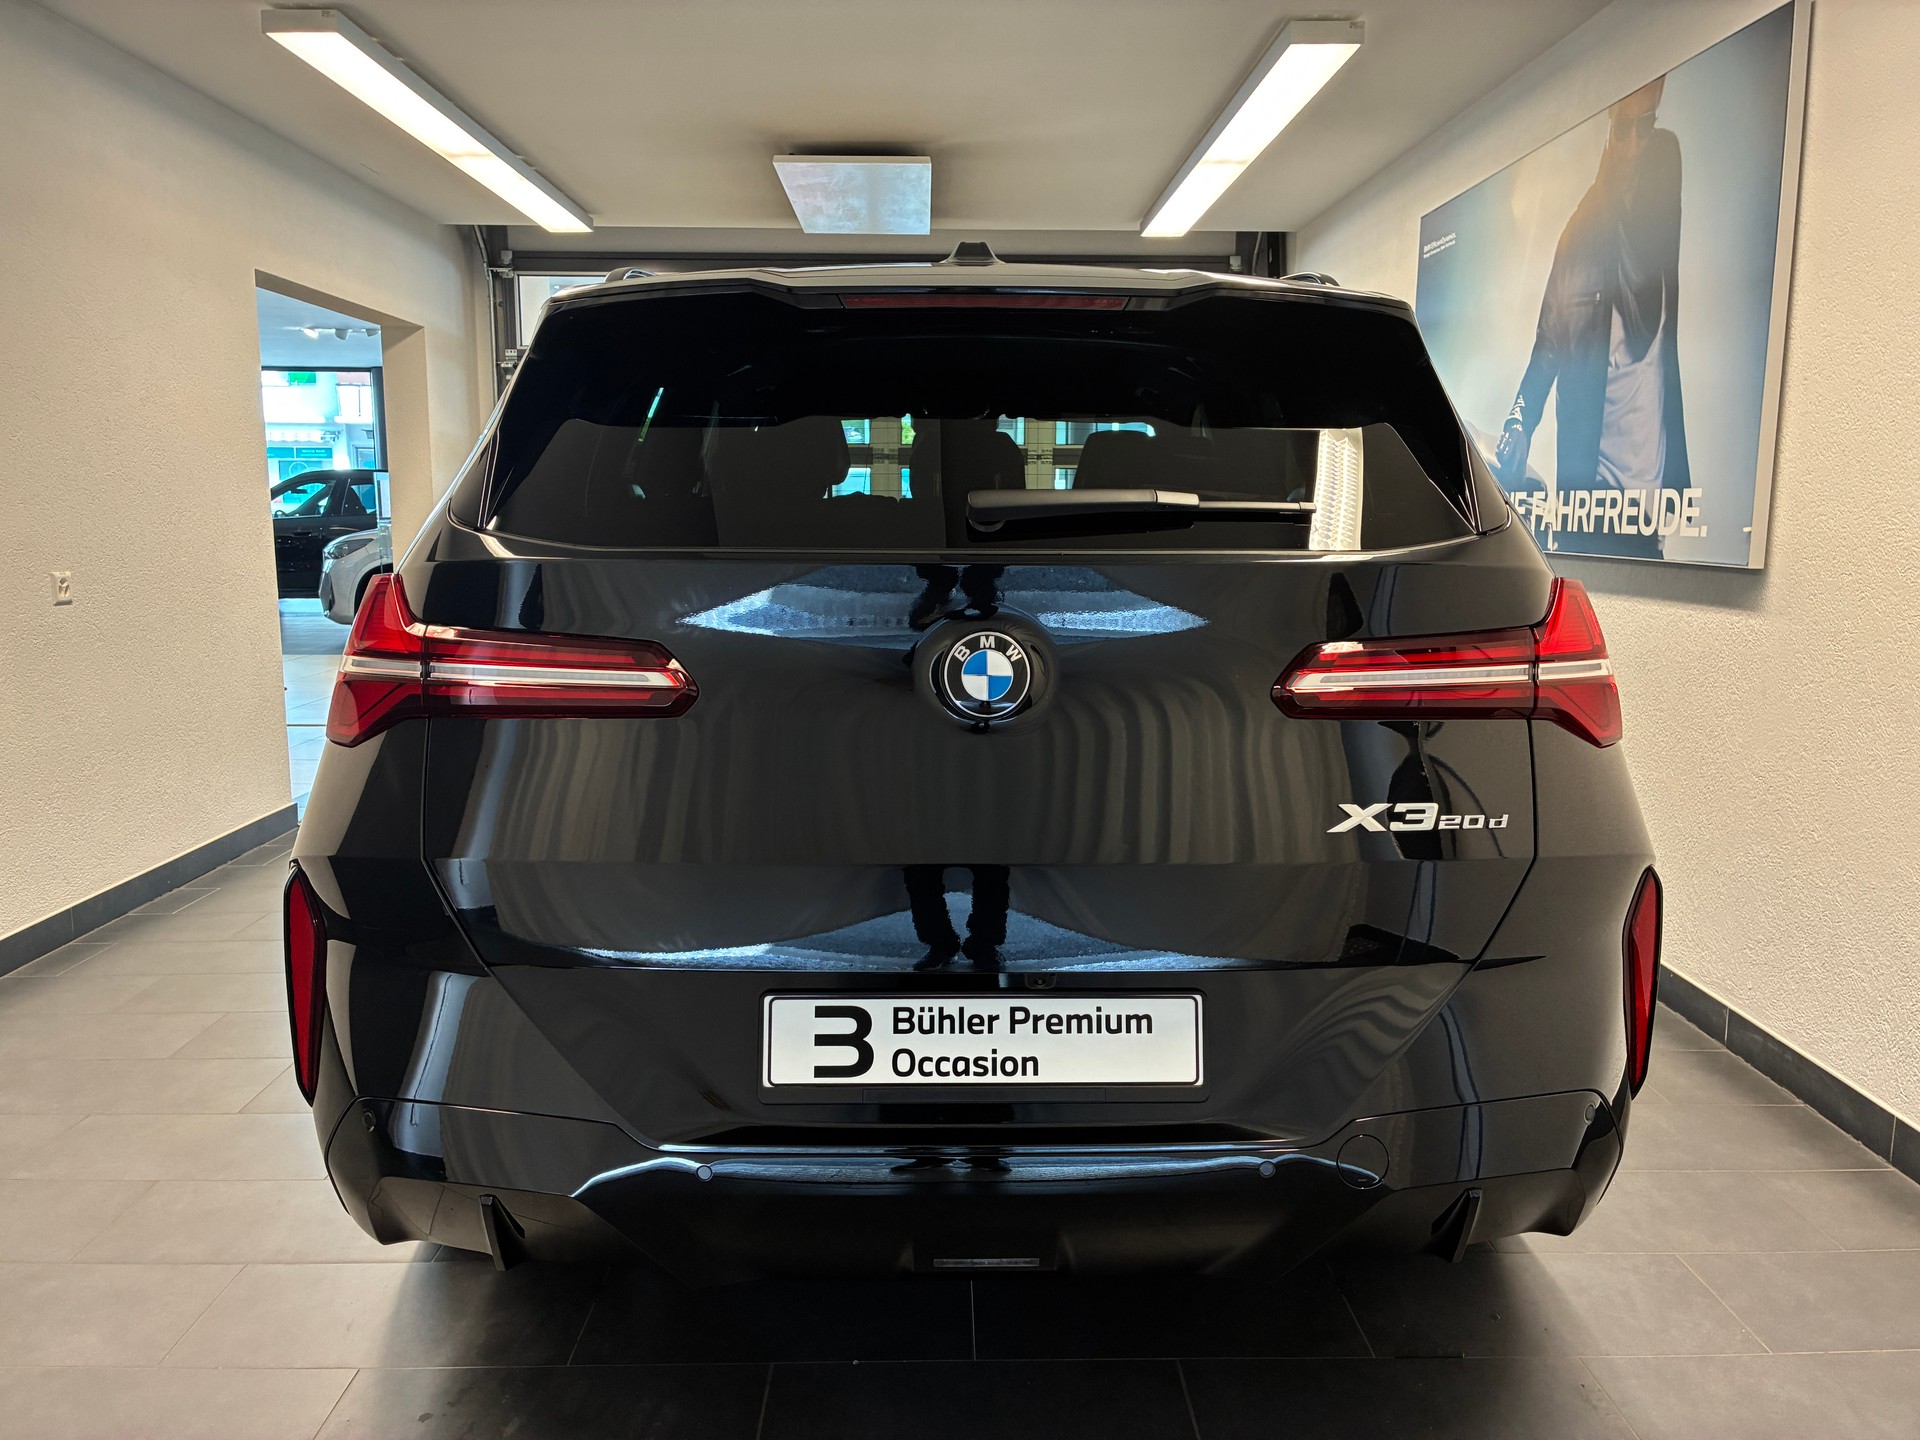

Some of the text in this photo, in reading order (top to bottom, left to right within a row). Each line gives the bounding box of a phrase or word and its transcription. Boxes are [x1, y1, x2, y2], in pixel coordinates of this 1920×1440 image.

[1531, 487, 1708, 538] FAHRFREUDE.
[953, 635, 1023, 663] BMW
[1326, 802, 1510, 833] X3 20d
[892, 1006, 1153, 1035] Bühler Premium
[891, 1048, 1039, 1078] Occasion
